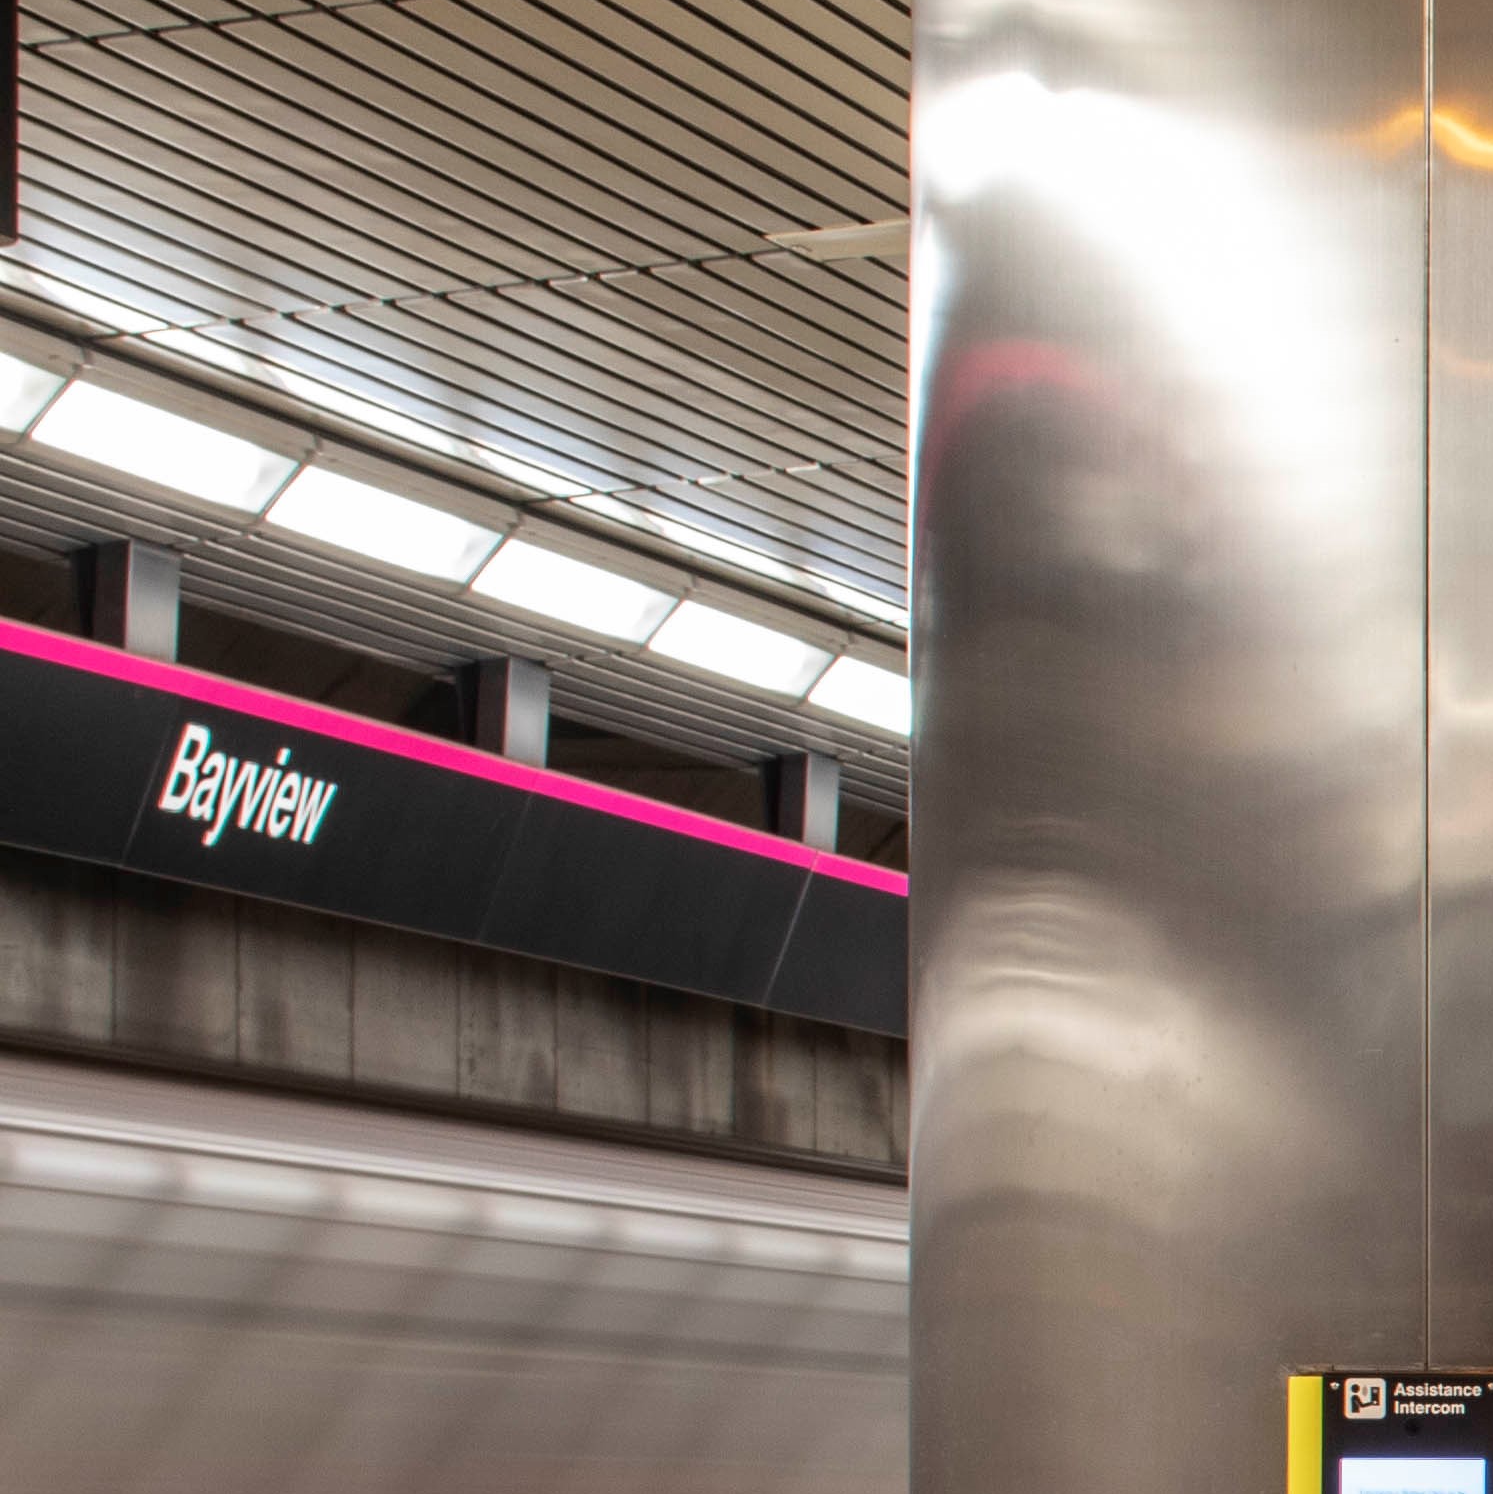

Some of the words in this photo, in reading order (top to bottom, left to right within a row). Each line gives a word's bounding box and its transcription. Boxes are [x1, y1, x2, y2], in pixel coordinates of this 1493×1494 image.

[158, 723, 338, 847] Bayview
[1394, 1382, 1483, 1398] Assistance
[1394, 1400, 1466, 1415] Intercom
